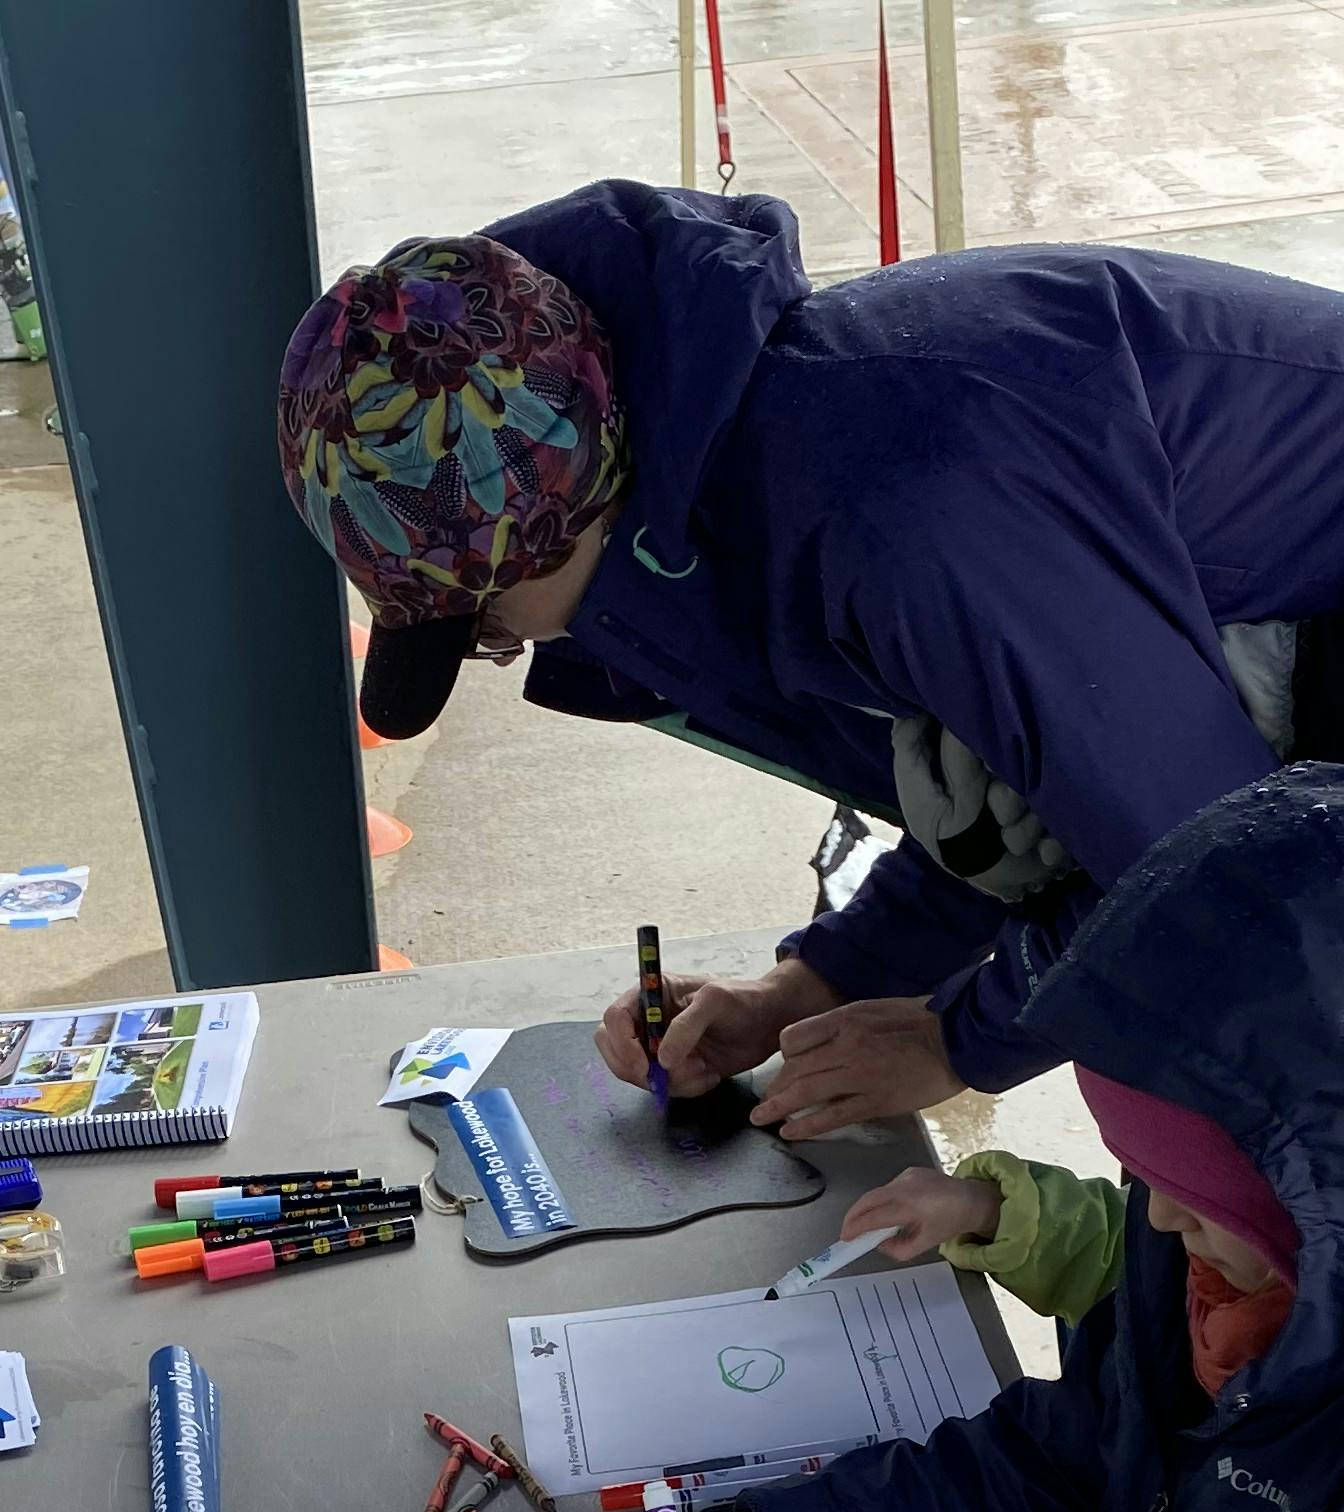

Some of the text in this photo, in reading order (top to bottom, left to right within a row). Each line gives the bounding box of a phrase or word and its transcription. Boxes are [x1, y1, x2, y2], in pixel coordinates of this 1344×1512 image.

[452, 1100, 536, 1231] My hope for Lakewood
[525, 1175, 560, 1210] 2040
[546, 1210, 567, 1226] in
[178, 1392, 195, 1413] en
[176, 1415, 202, 1449] hoy
